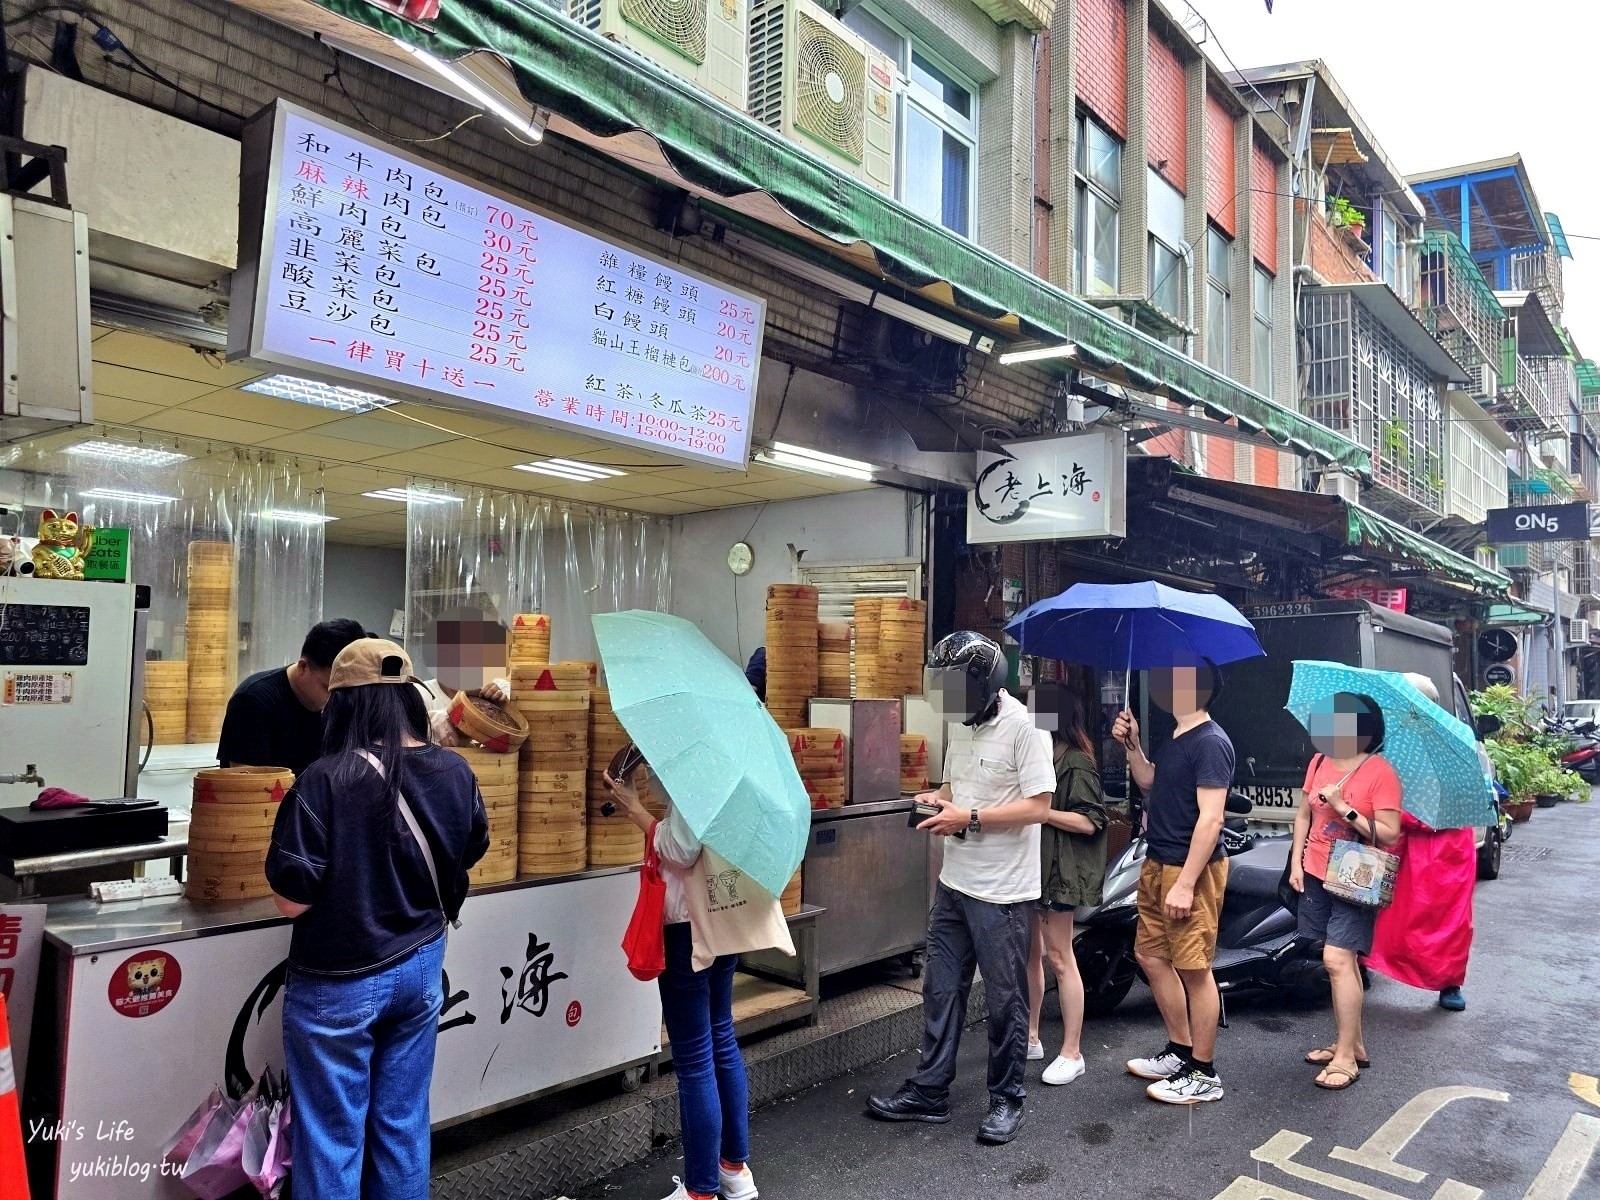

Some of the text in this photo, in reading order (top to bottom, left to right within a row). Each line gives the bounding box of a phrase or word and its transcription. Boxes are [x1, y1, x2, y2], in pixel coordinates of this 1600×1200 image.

[294, 159, 537, 263] 麻辣肉包 30元
[297, 132, 448, 205] 和牛肉包
[487, 205, 539, 241] 70元
[289, 211, 532, 308] 高麗菜包 25元
[290, 182, 534, 286] 鮮肉包 25元
[282, 262, 528, 351] 酸菜包 25元
[286, 238, 530, 329] 韭菜包 25元
[596, 275, 752, 346] 紅糖饅頭 20元
[599, 250, 755, 325] 雜糧饅頭 25元
[280, 291, 525, 373] 豆沙包 25元
[308, 335, 495, 389] 一律買十送一
[594, 302, 750, 369] 白饅頭 20元
[702, 364, 746, 391] 200元
[707, 410, 743, 432] 25元
[995, 462, 1093, 504] 老上海
